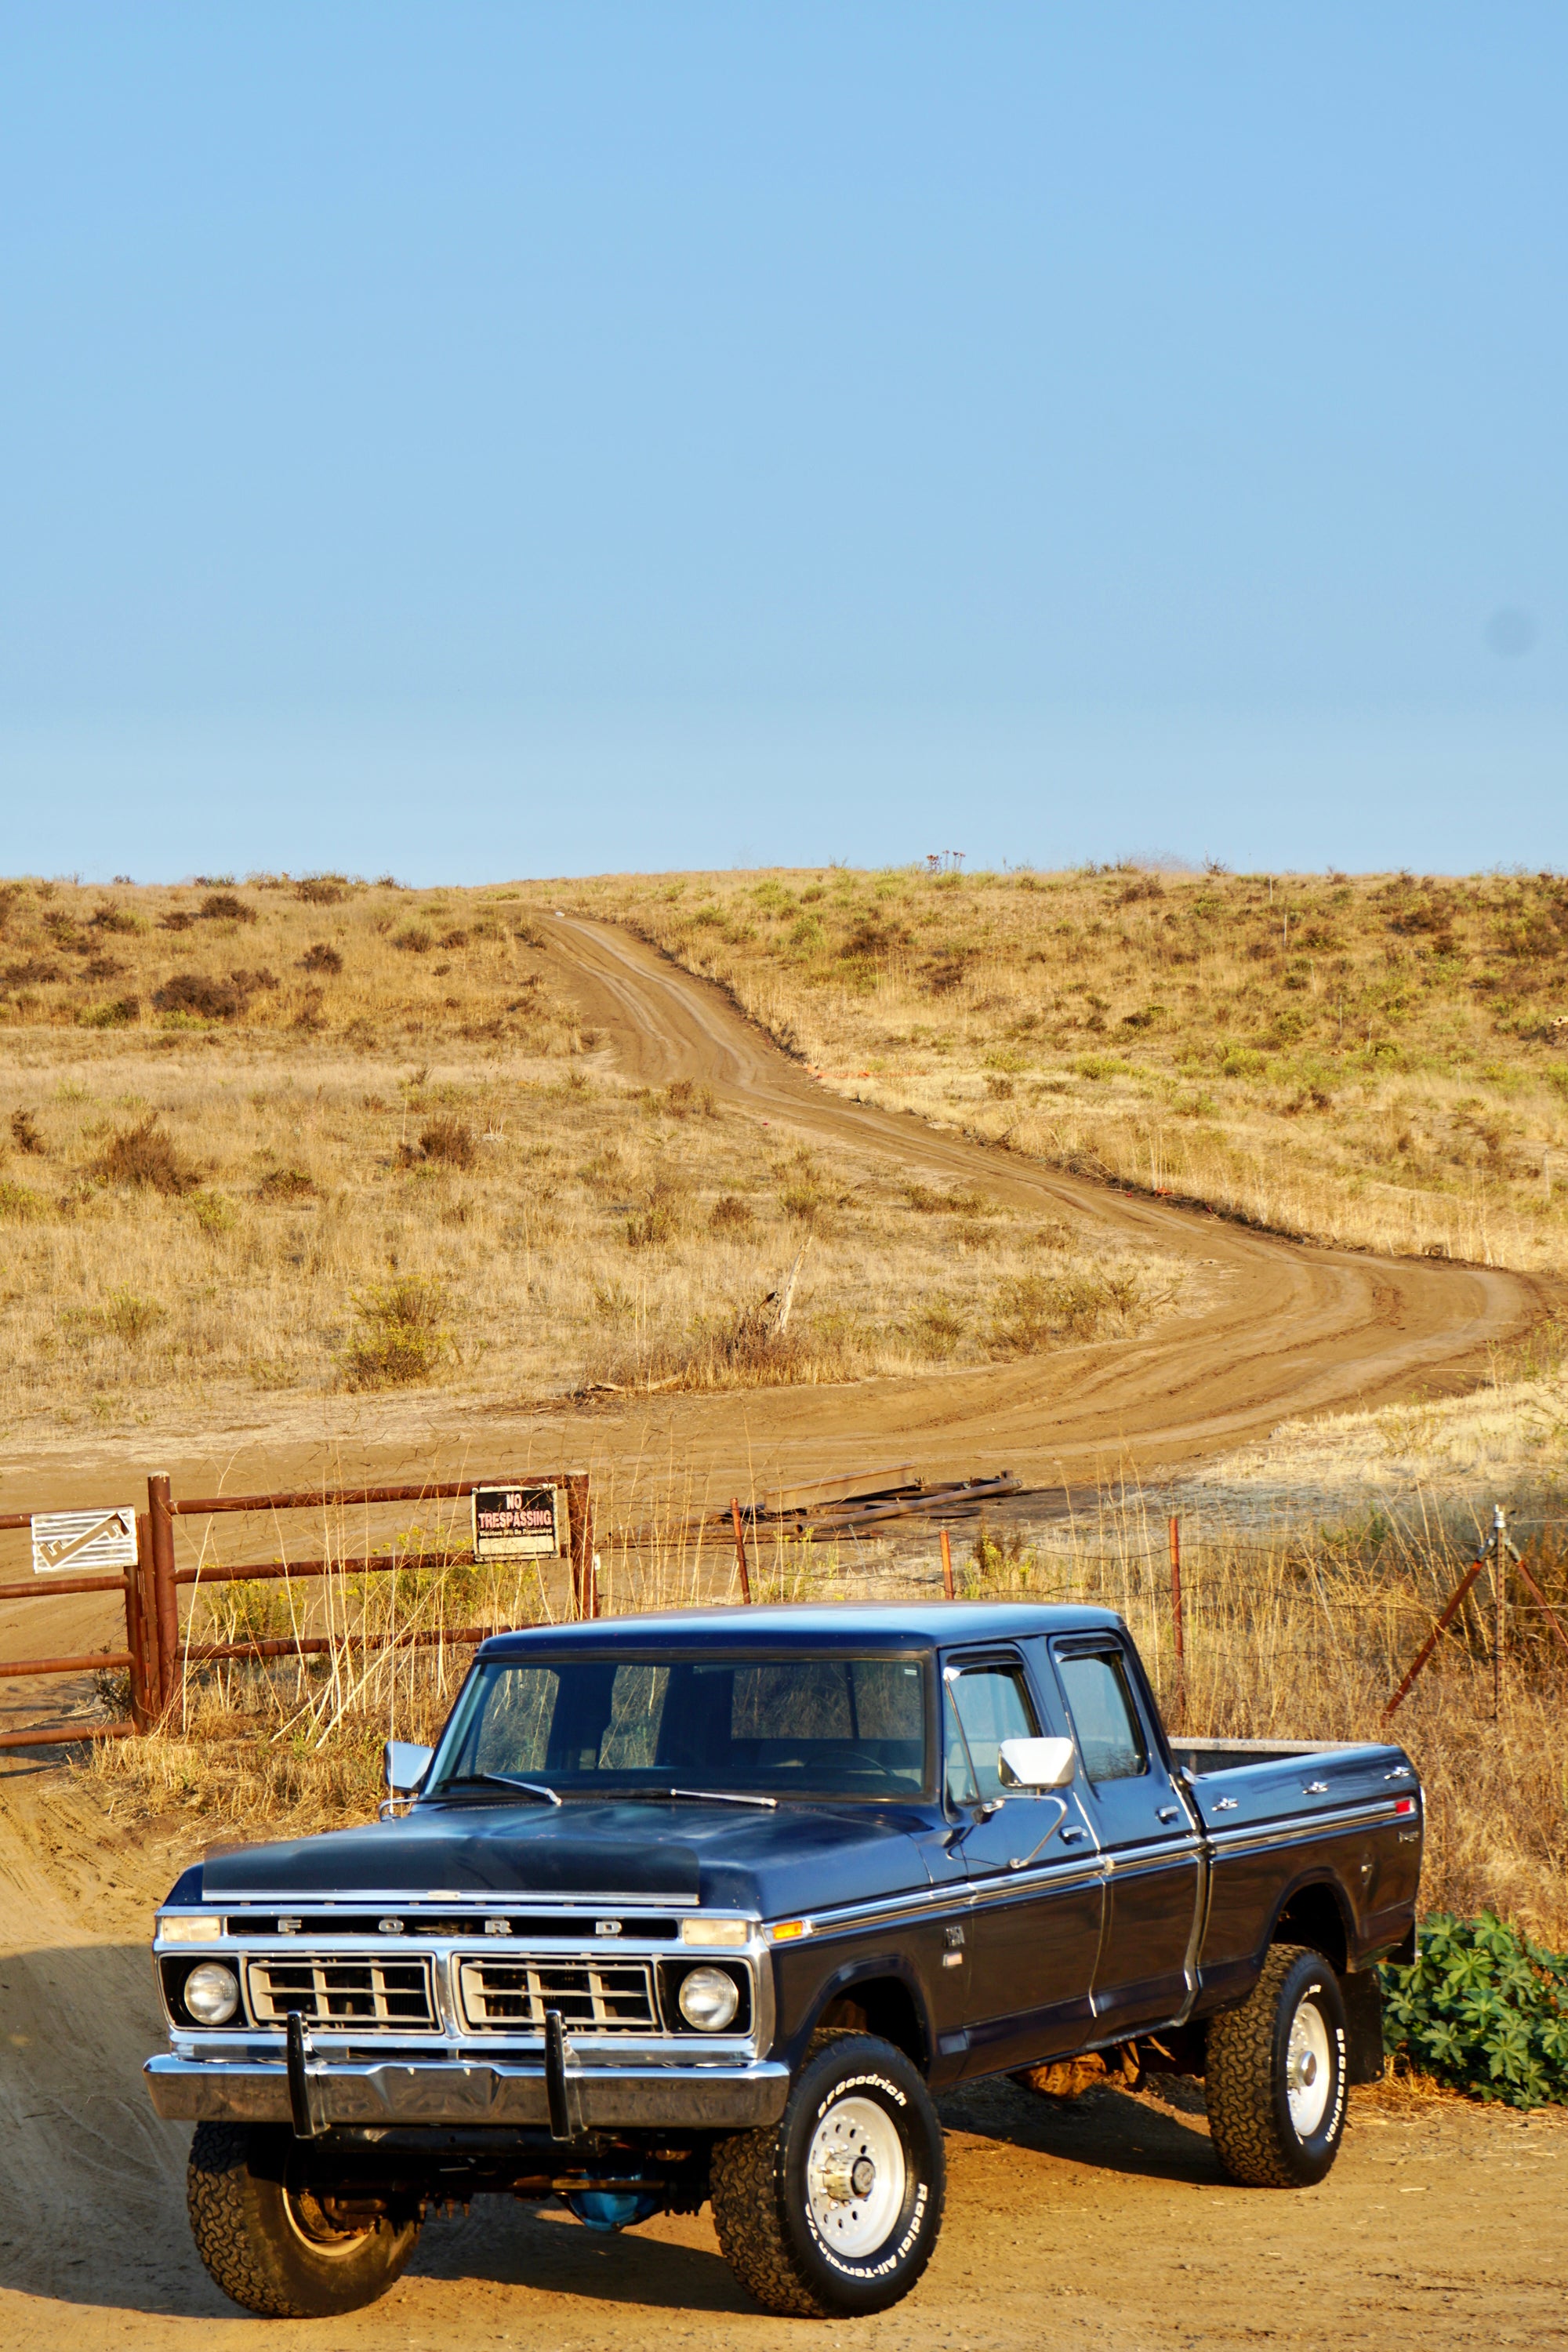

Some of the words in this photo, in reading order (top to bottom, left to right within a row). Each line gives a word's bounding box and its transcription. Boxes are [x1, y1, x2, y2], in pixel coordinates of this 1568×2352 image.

[506, 1494, 522, 1509] NO
[478, 1510, 552, 1528] TRESPASSING
[278, 1919, 622, 1934] FORD
[897, 2183, 928, 2259] Radial
[818, 2241, 898, 2278] All-Terrain
